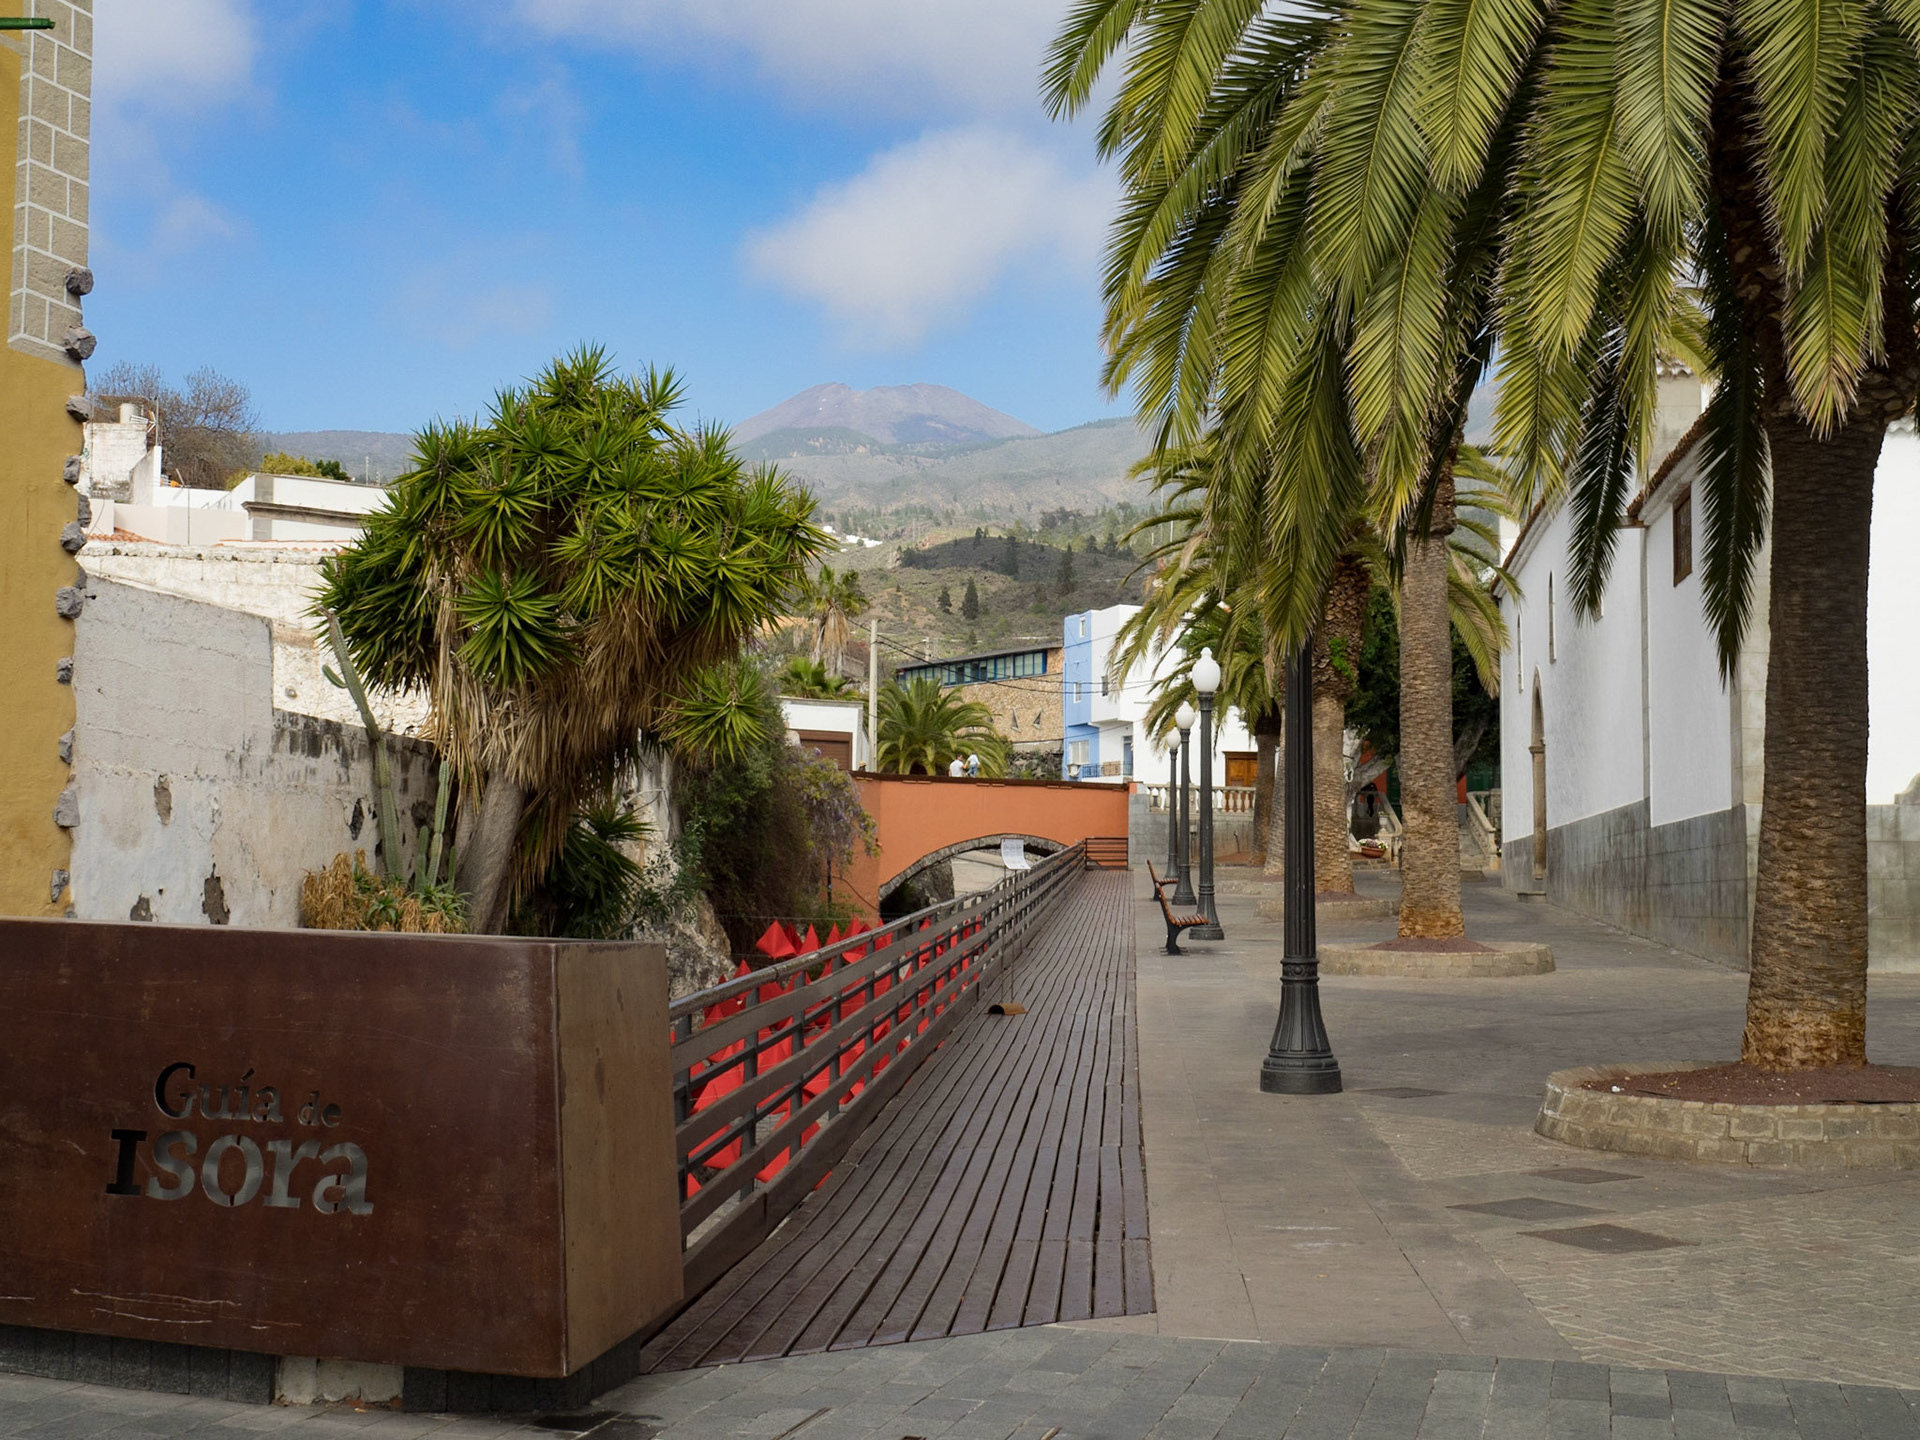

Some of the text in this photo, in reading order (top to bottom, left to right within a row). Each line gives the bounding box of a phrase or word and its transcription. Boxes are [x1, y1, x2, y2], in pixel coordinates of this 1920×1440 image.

[154, 1062, 342, 1128] Guía de
[105, 1128, 374, 1215] Isora
